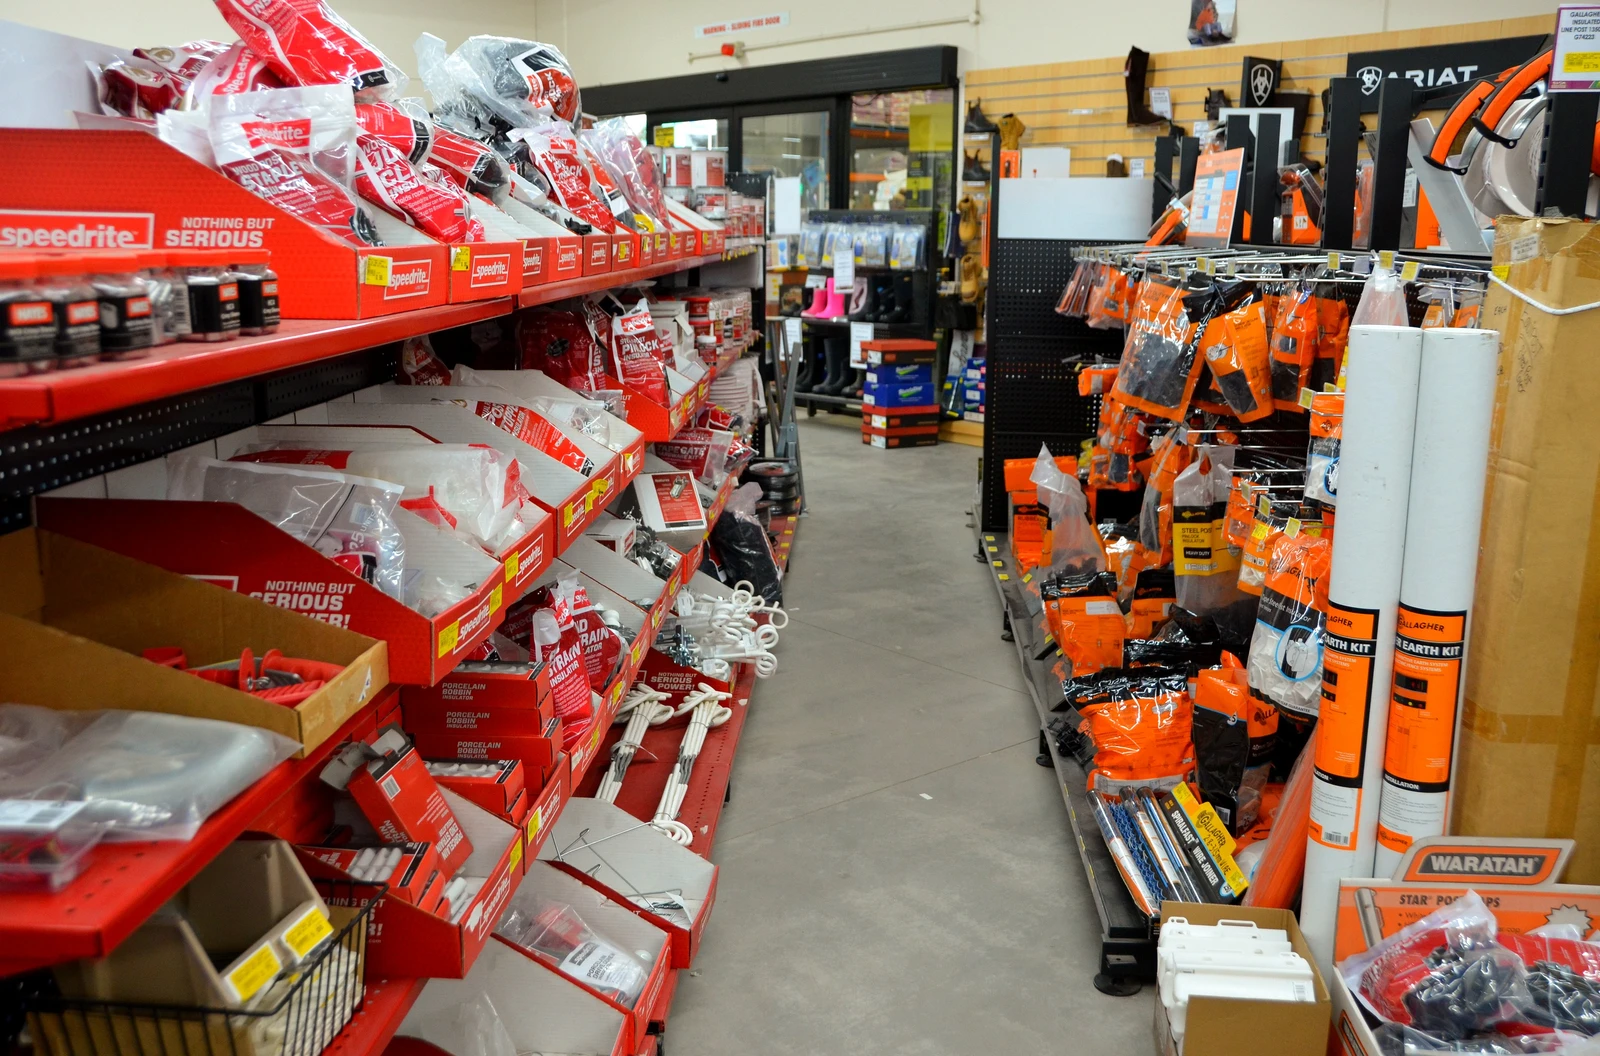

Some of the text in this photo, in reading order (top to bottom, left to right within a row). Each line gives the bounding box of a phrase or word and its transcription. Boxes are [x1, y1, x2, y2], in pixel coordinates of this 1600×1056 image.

[703, 24, 726, 35] WARNING
[731, 21, 751, 31] SLIDING
[752, 18, 763, 27] FIRE
[765, 16, 780, 26] DOOR
[182, 218, 275, 229] NOTHING BUT
[1, 225, 134, 248] speedrite
[166, 231, 264, 247] SERIOUS
[477, 262, 507, 280] speedrite
[676, 430, 709, 439] peedrite
[266, 580, 356, 594] NOTHING BUT
[460, 604, 490, 640] speedrite
[1398, 616, 1445, 632] GALLAGHER
[1350, 642, 1370, 653] KIT
[1403, 641, 1460, 656] EARTH KIT
[548, 641, 582, 678] STRAIN
[550, 660, 579, 688] INSULATOR
[651, 676, 693, 684] SERIOUS
[442, 682, 487, 690] PORCELAIN
[657, 682, 696, 691] POWER!
[446, 711, 490, 719] PORCELAIN
[457, 741, 501, 749] PORCELAIN
[1200, 815, 1226, 848] GALLAGHER
[1193, 845, 1219, 886] WIRE JOINER
[1431, 855, 1534, 873] WARATAH
[1400, 894, 1427, 905] STAR
